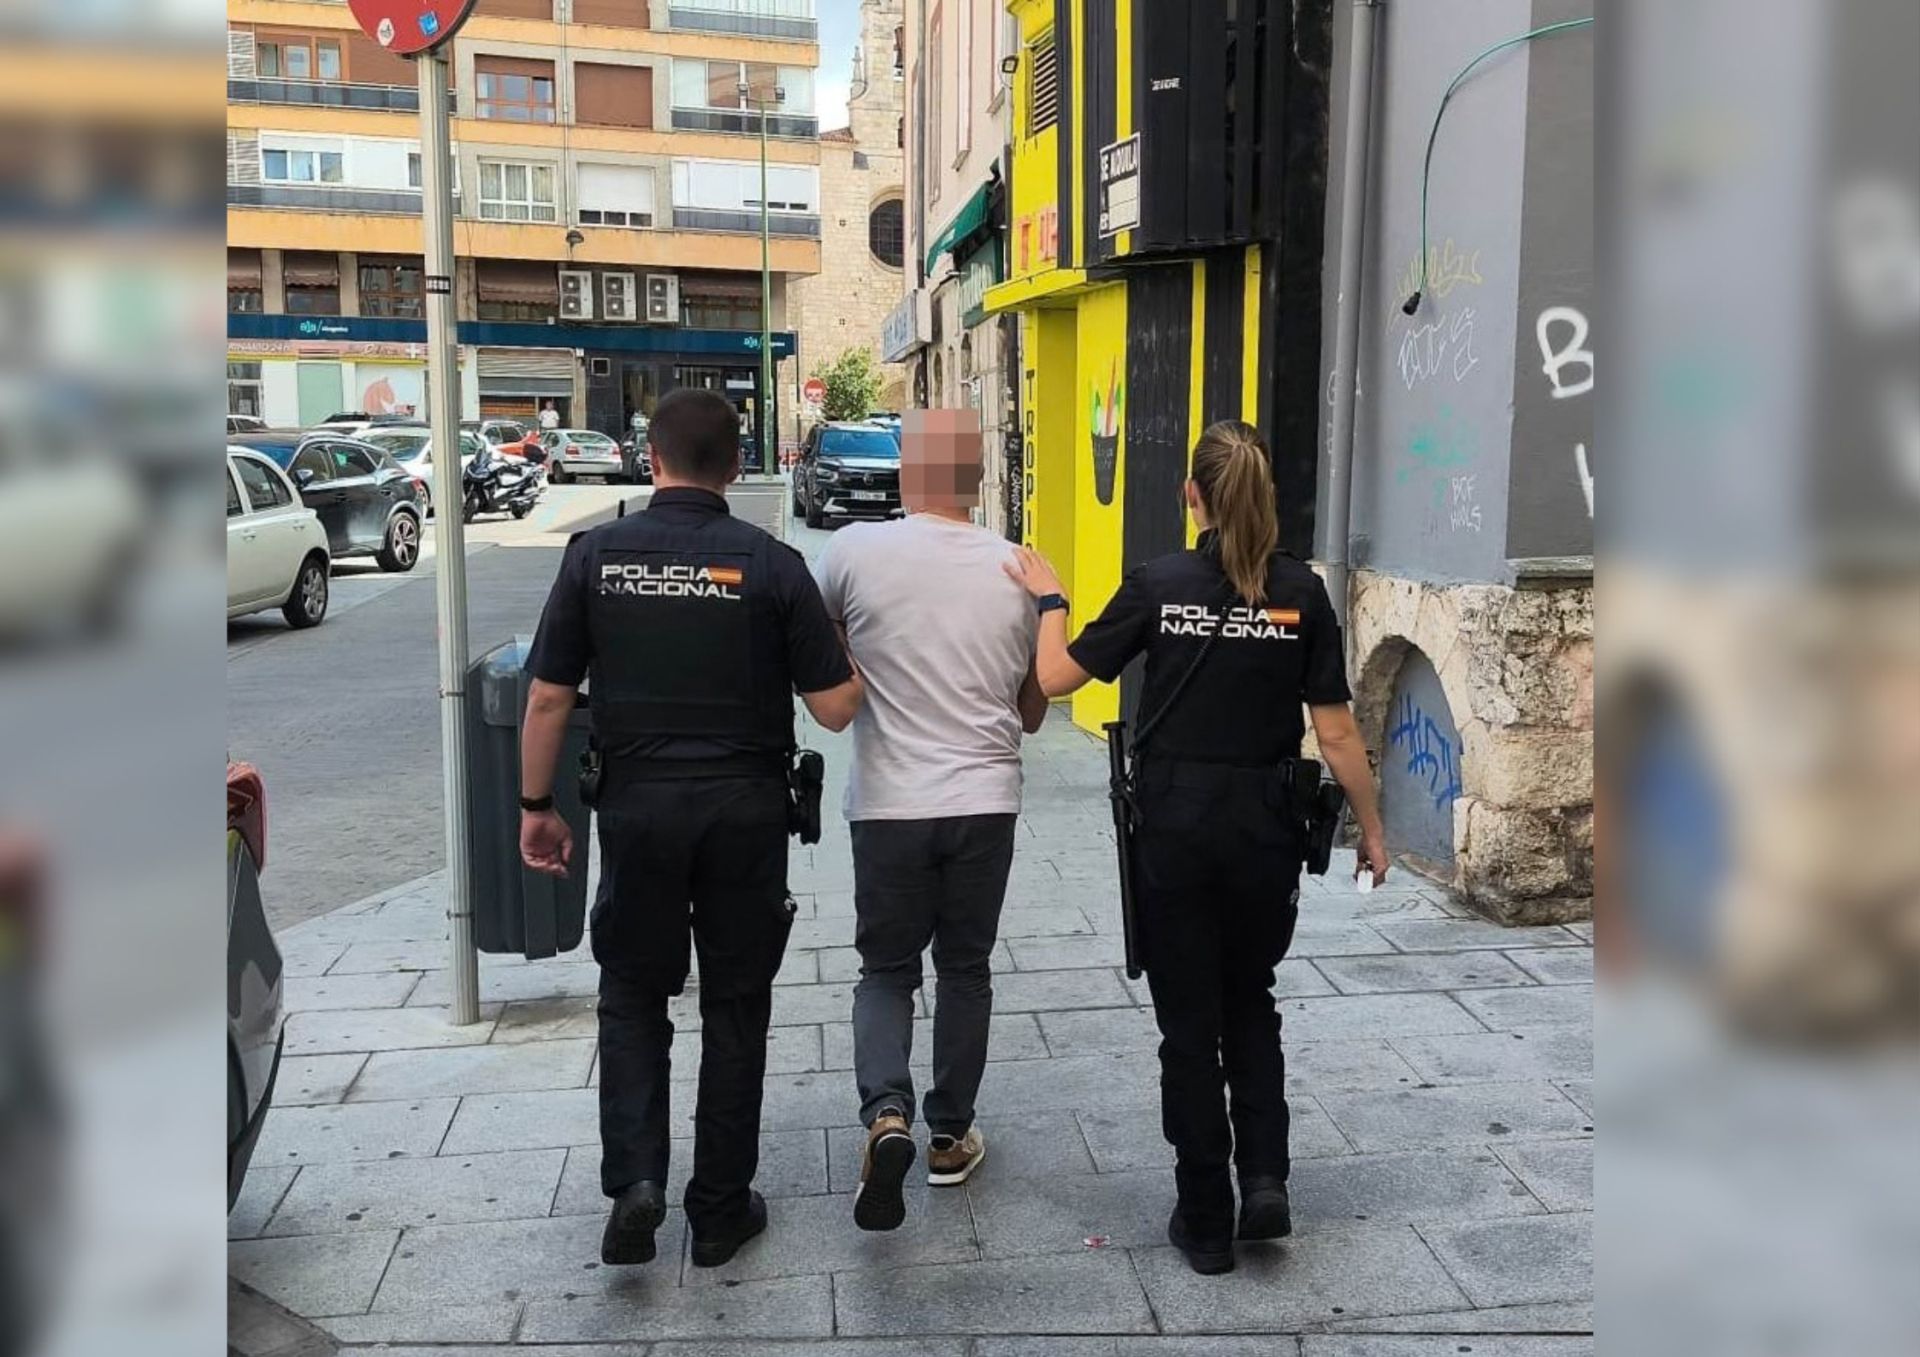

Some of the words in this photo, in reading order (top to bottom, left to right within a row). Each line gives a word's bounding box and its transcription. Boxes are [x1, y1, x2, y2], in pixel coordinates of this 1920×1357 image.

[601, 564, 712, 581] POLICIA
[600, 581, 741, 600] NACIONAL
[1161, 604, 1271, 623] POLCIA
[1160, 620, 1299, 639] NACONAL
